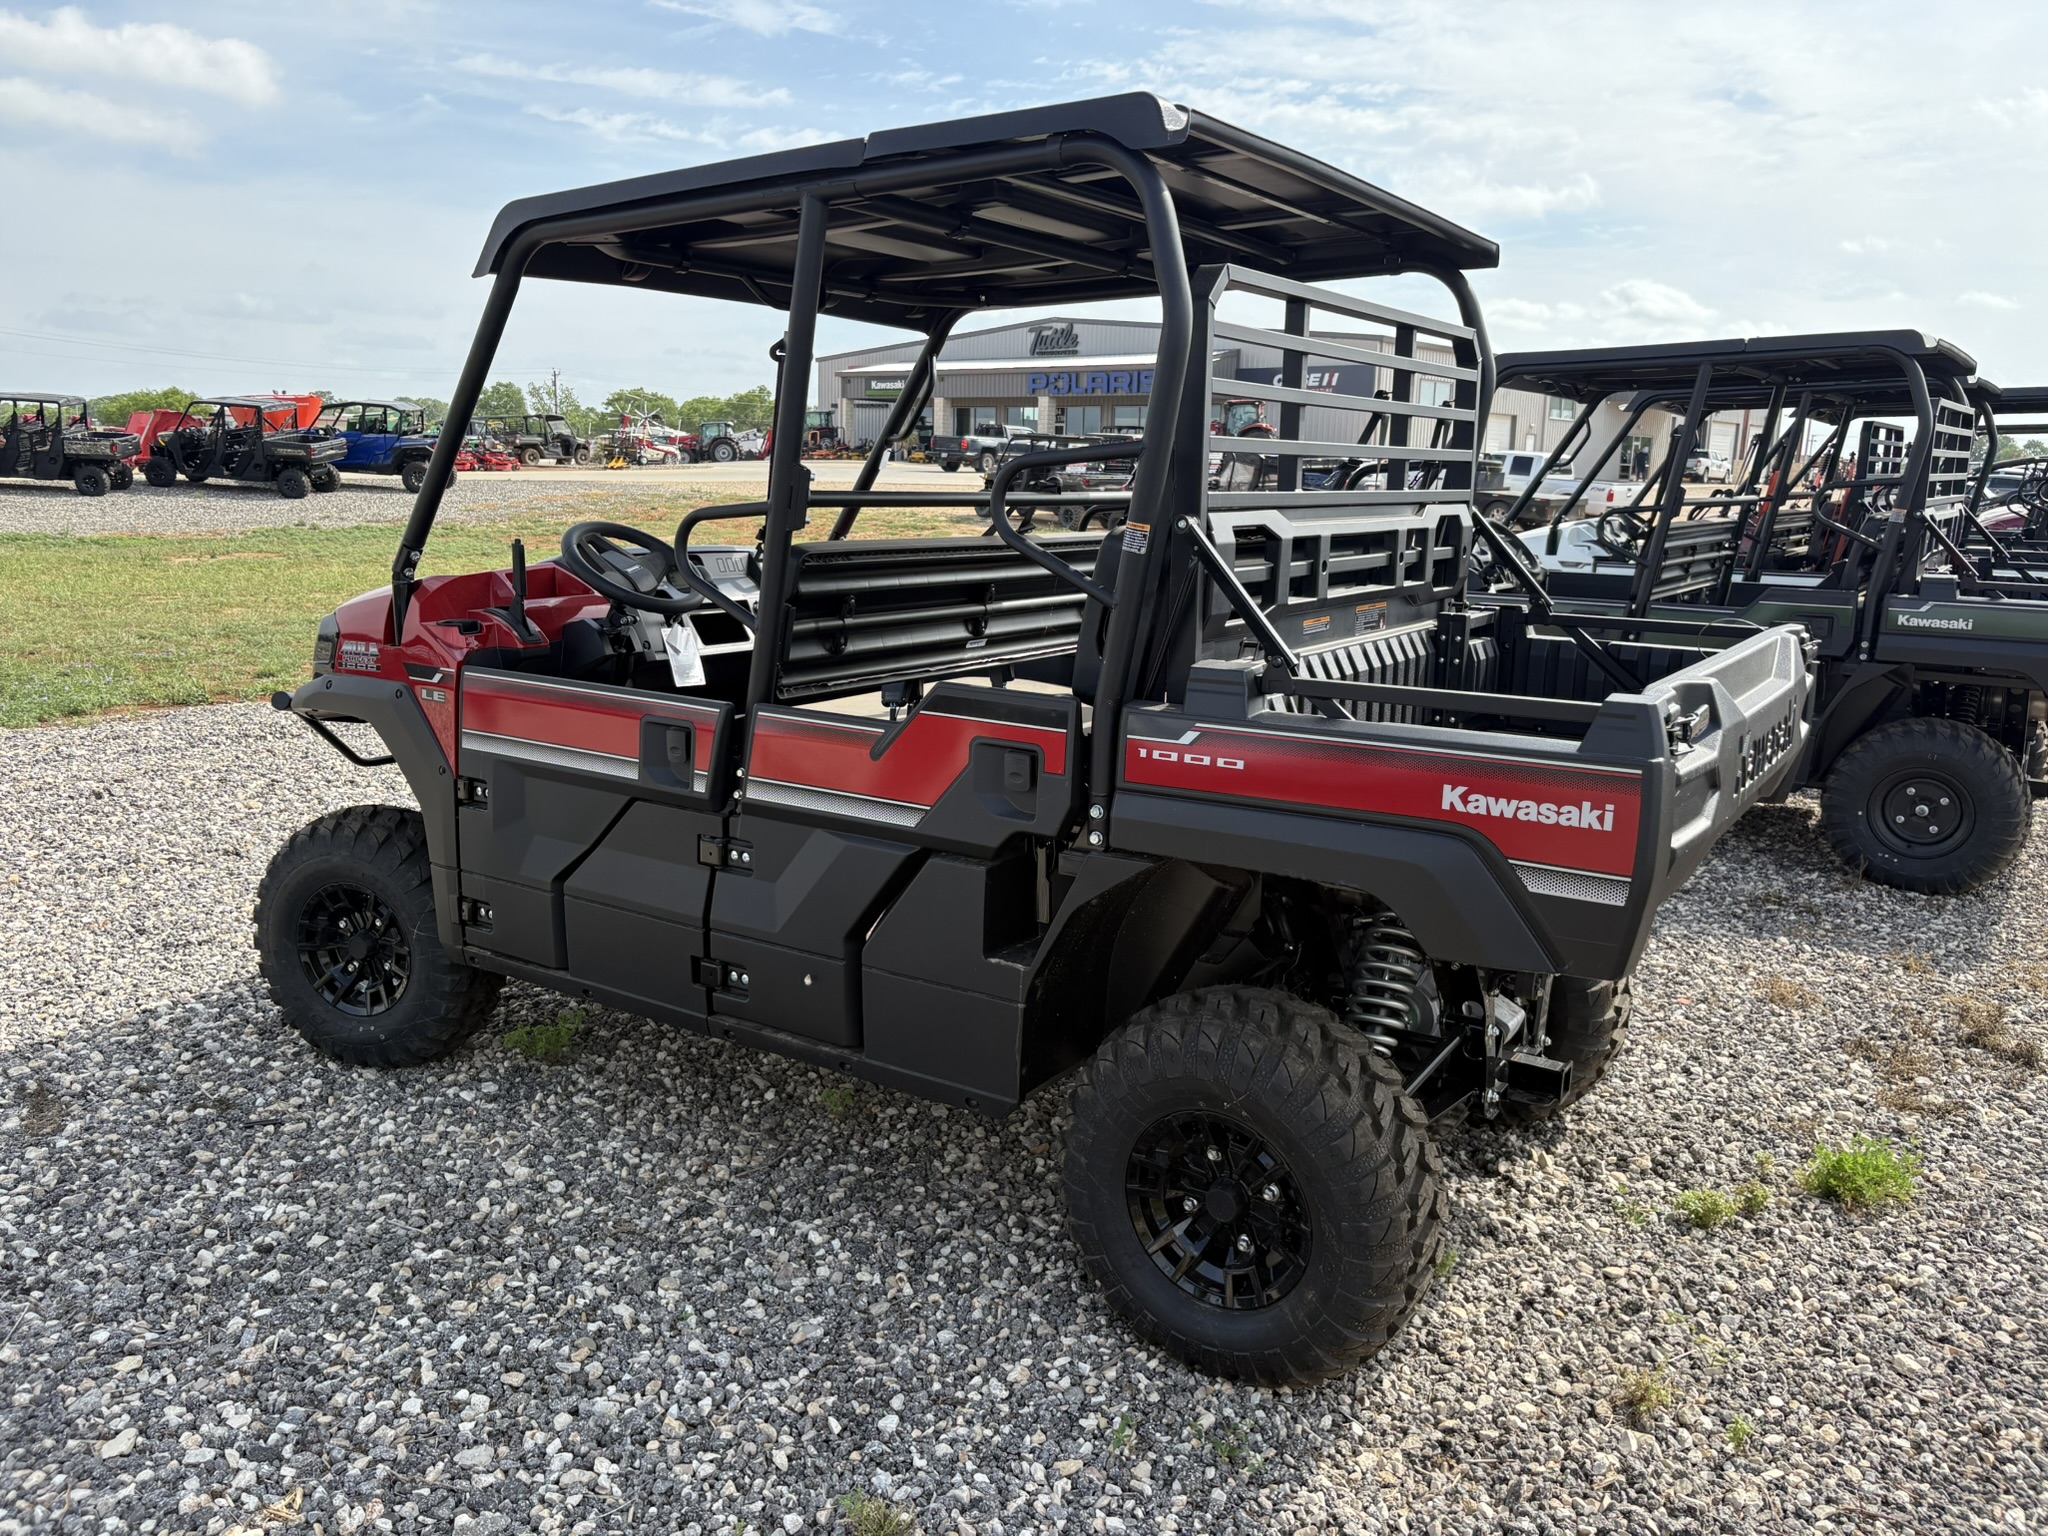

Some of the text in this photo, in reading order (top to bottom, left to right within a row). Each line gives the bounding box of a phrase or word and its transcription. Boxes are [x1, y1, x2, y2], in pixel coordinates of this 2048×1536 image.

[1028, 322, 1079, 356] Tuttle
[871, 380, 905, 390] Kawasaki
[1028, 370, 1155, 395] POLARIS
[1897, 614, 1973, 630] Kawasaki
[421, 688, 446, 703] LE
[1138, 747, 1245, 770] 1000
[1441, 784, 1615, 832] Kawasaki
